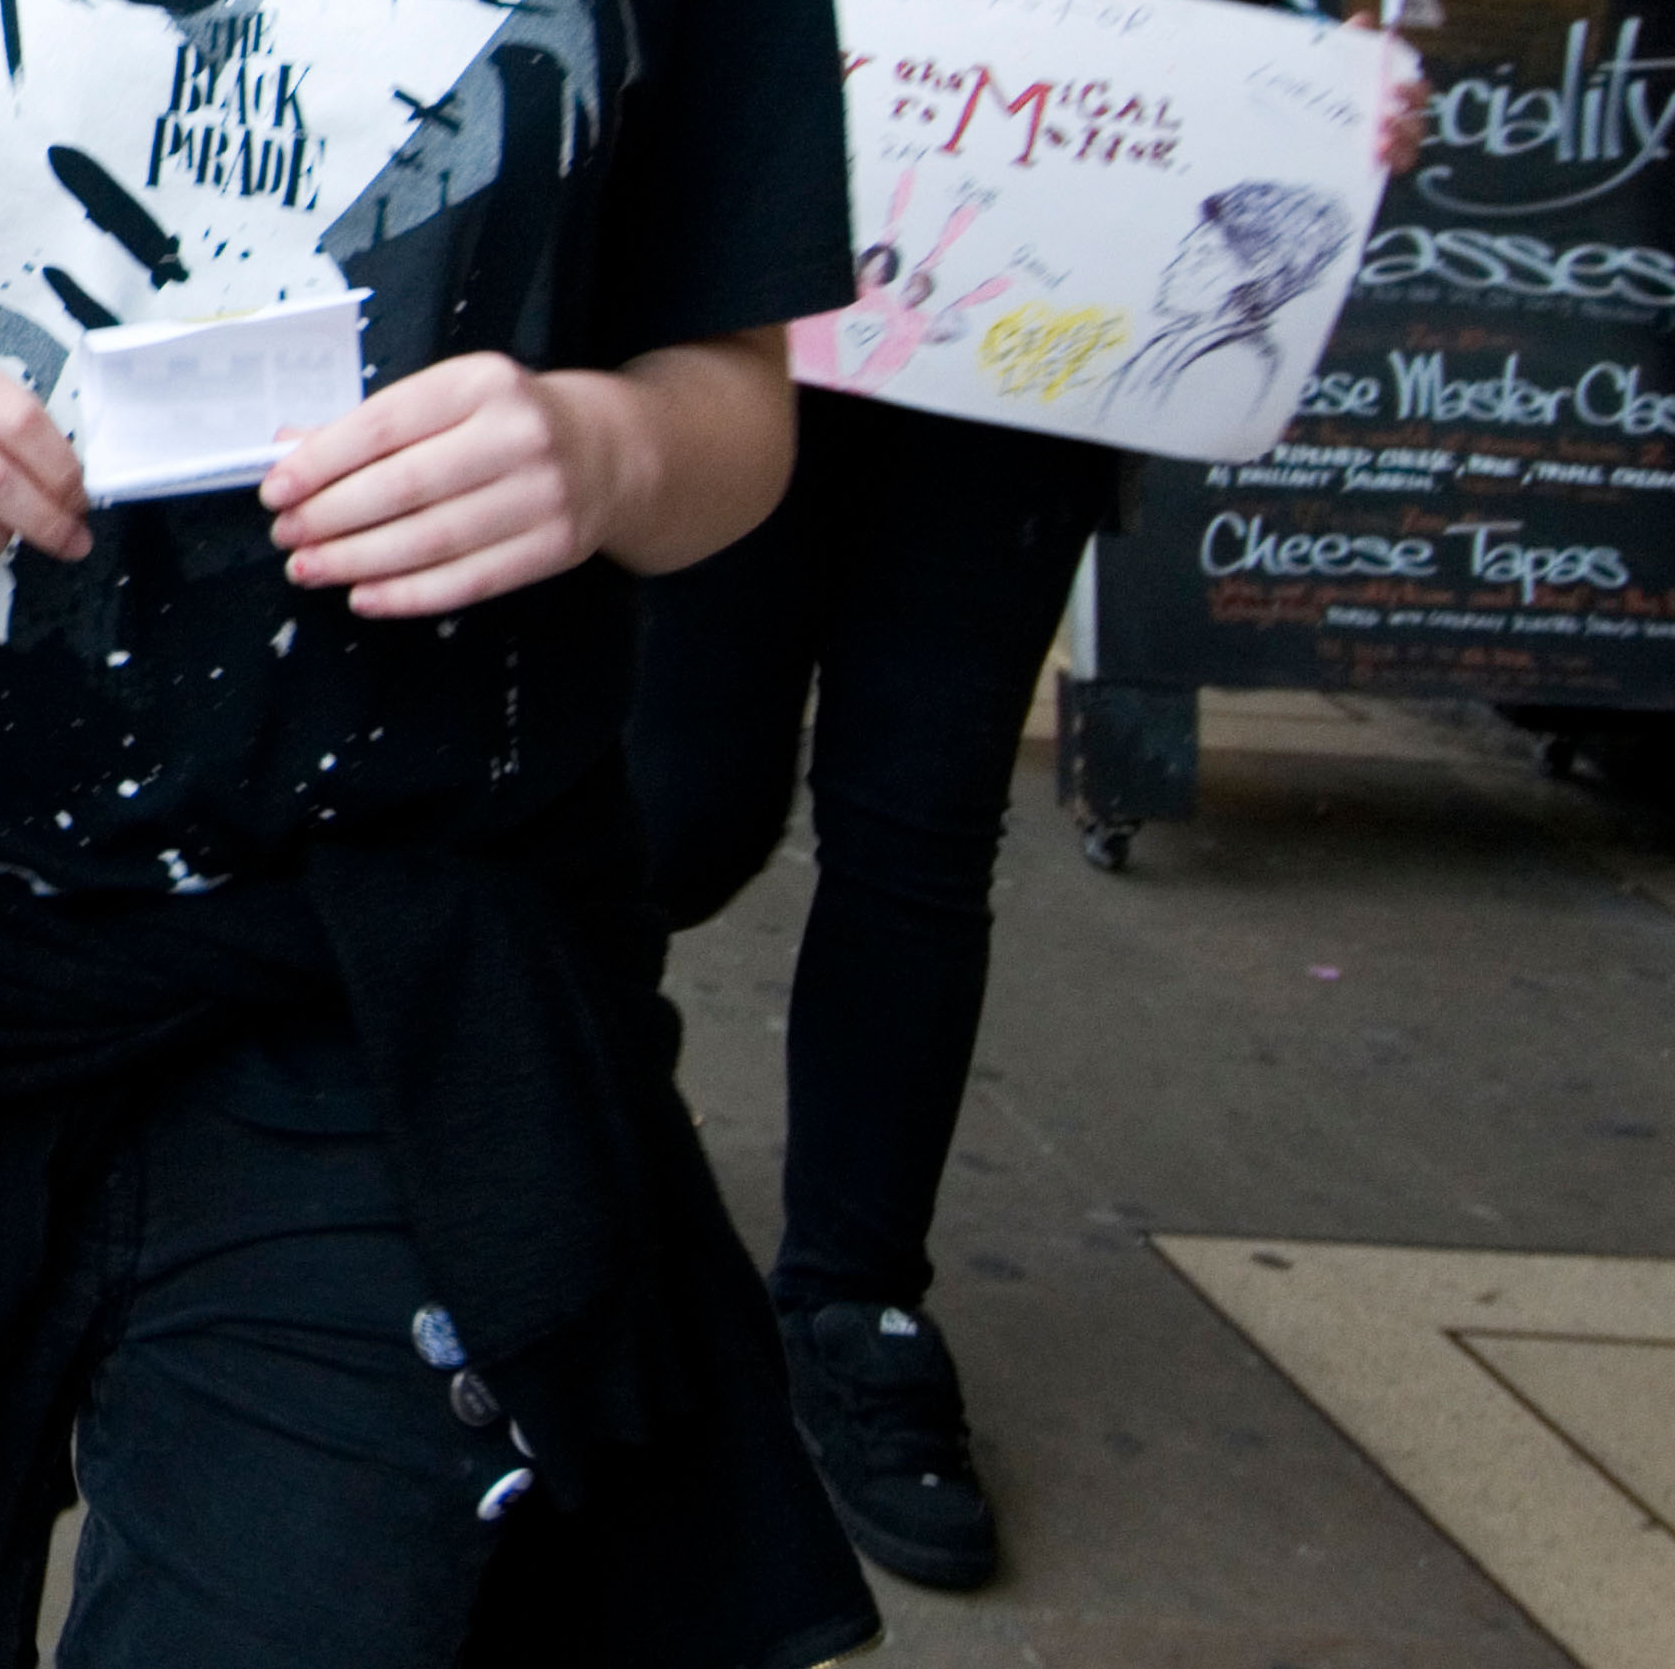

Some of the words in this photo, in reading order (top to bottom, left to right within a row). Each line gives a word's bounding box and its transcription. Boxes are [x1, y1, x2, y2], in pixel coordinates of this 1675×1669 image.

[167, 43, 312, 132] BLACK
[145, 117, 326, 211] PARADE
[1389, 350, 1573, 425] Master
[1199, 511, 1436, 577] Cheese
[1444, 519, 1630, 605] Tapas
